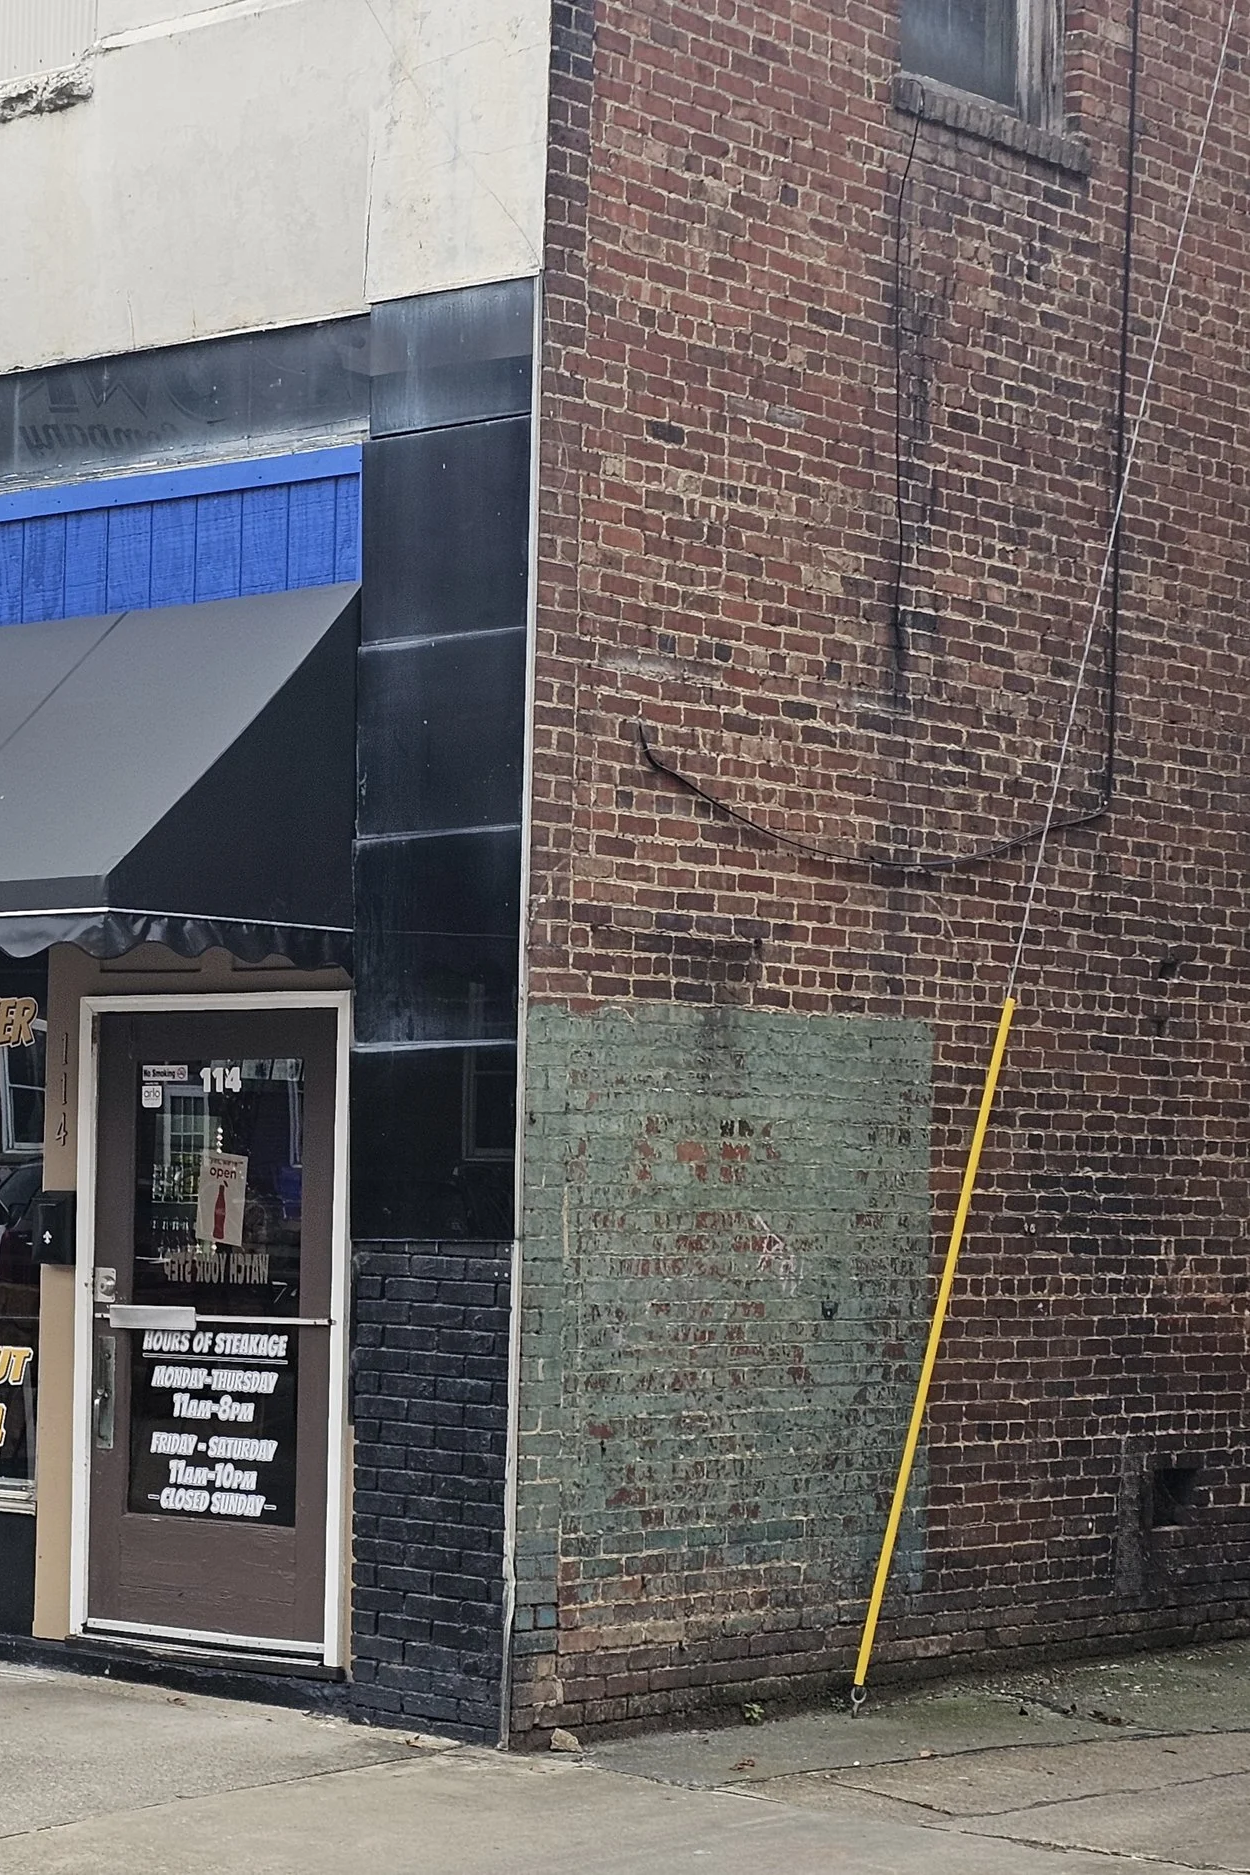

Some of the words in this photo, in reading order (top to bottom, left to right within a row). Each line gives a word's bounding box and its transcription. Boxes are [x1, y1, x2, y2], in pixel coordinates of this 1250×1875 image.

[152, 1068, 176, 1079] Smoking
[200, 1067, 242, 1093] 114
[143, 1087, 161, 1098] arlo
[210, 1167, 237, 1179] open
[143, 1330, 190, 1352] HOURS
[192, 1331, 213, 1353] OF
[214, 1332, 289, 1357] STEAKAGE
[151, 1365, 279, 1394] MONDAY-THURSDAY
[150, 1431, 198, 1456] FRIDAY
[207, 1436, 278, 1461] SATURDAY
